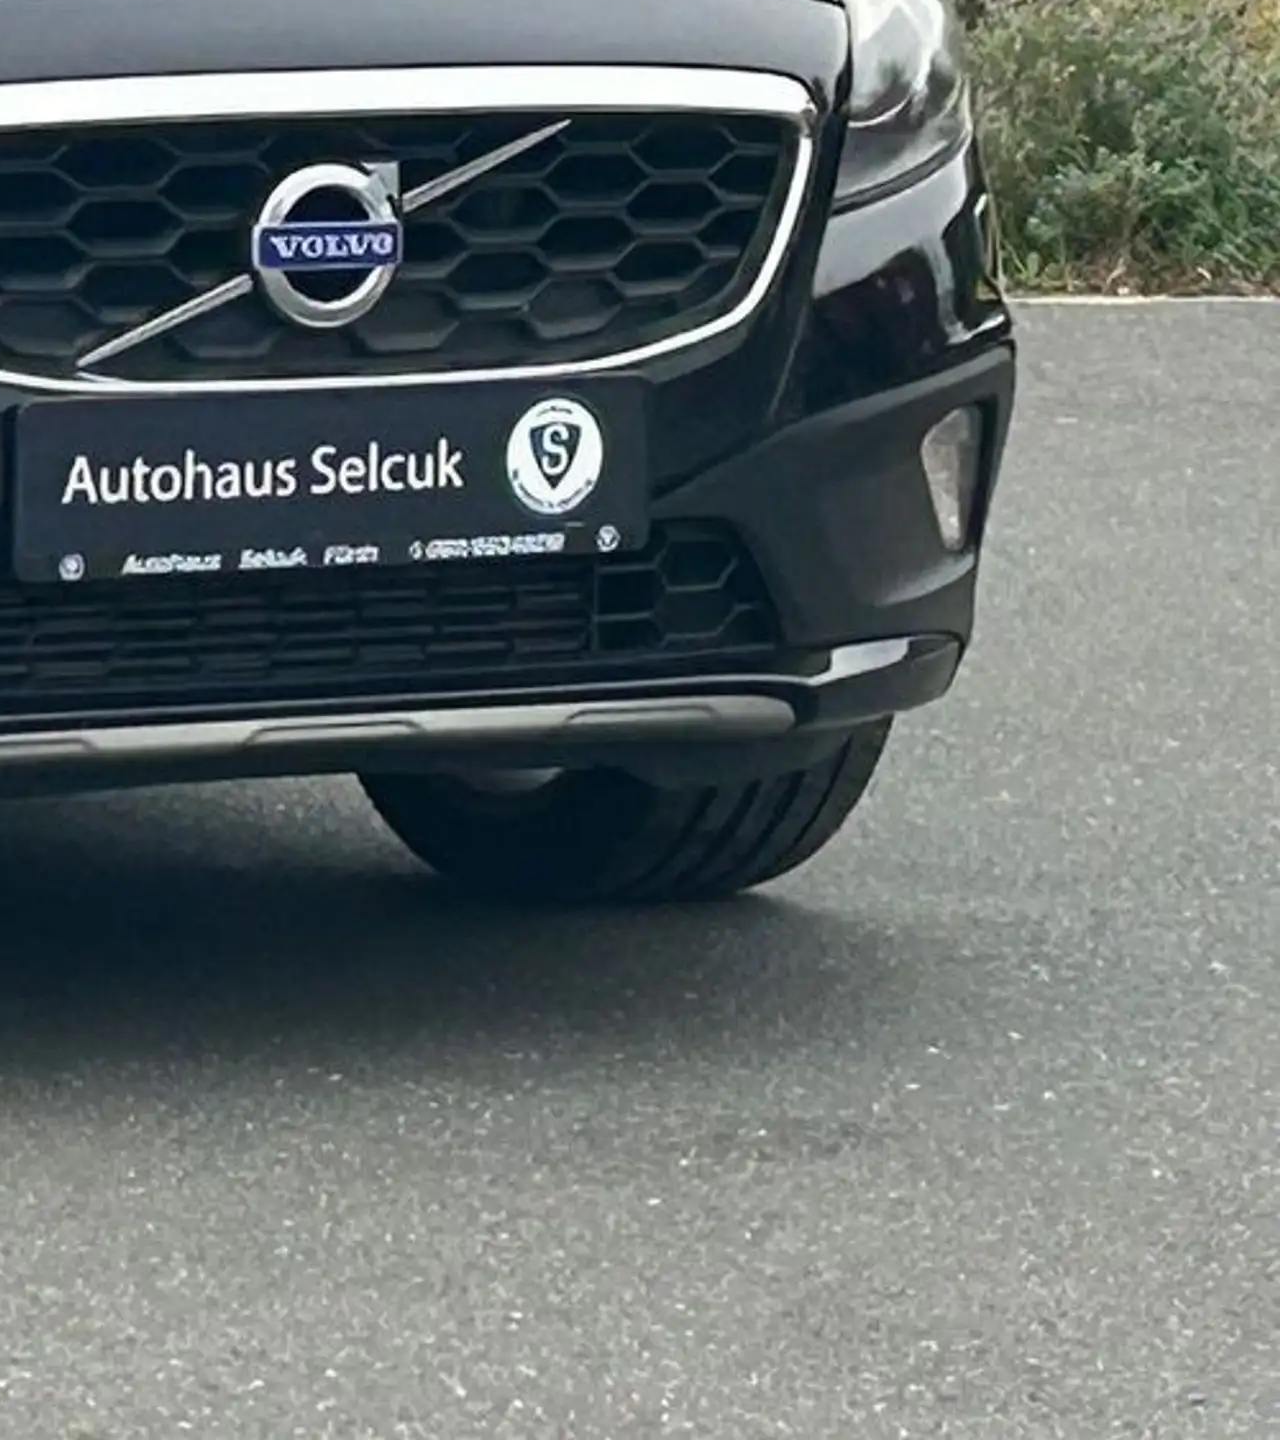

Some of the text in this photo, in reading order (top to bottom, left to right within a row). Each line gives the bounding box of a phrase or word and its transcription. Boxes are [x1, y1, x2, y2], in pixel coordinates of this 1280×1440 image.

[270, 231, 394, 259] VOLVO
[61, 448, 297, 505] Autohaus
[309, 437, 464, 496] Selcuk
